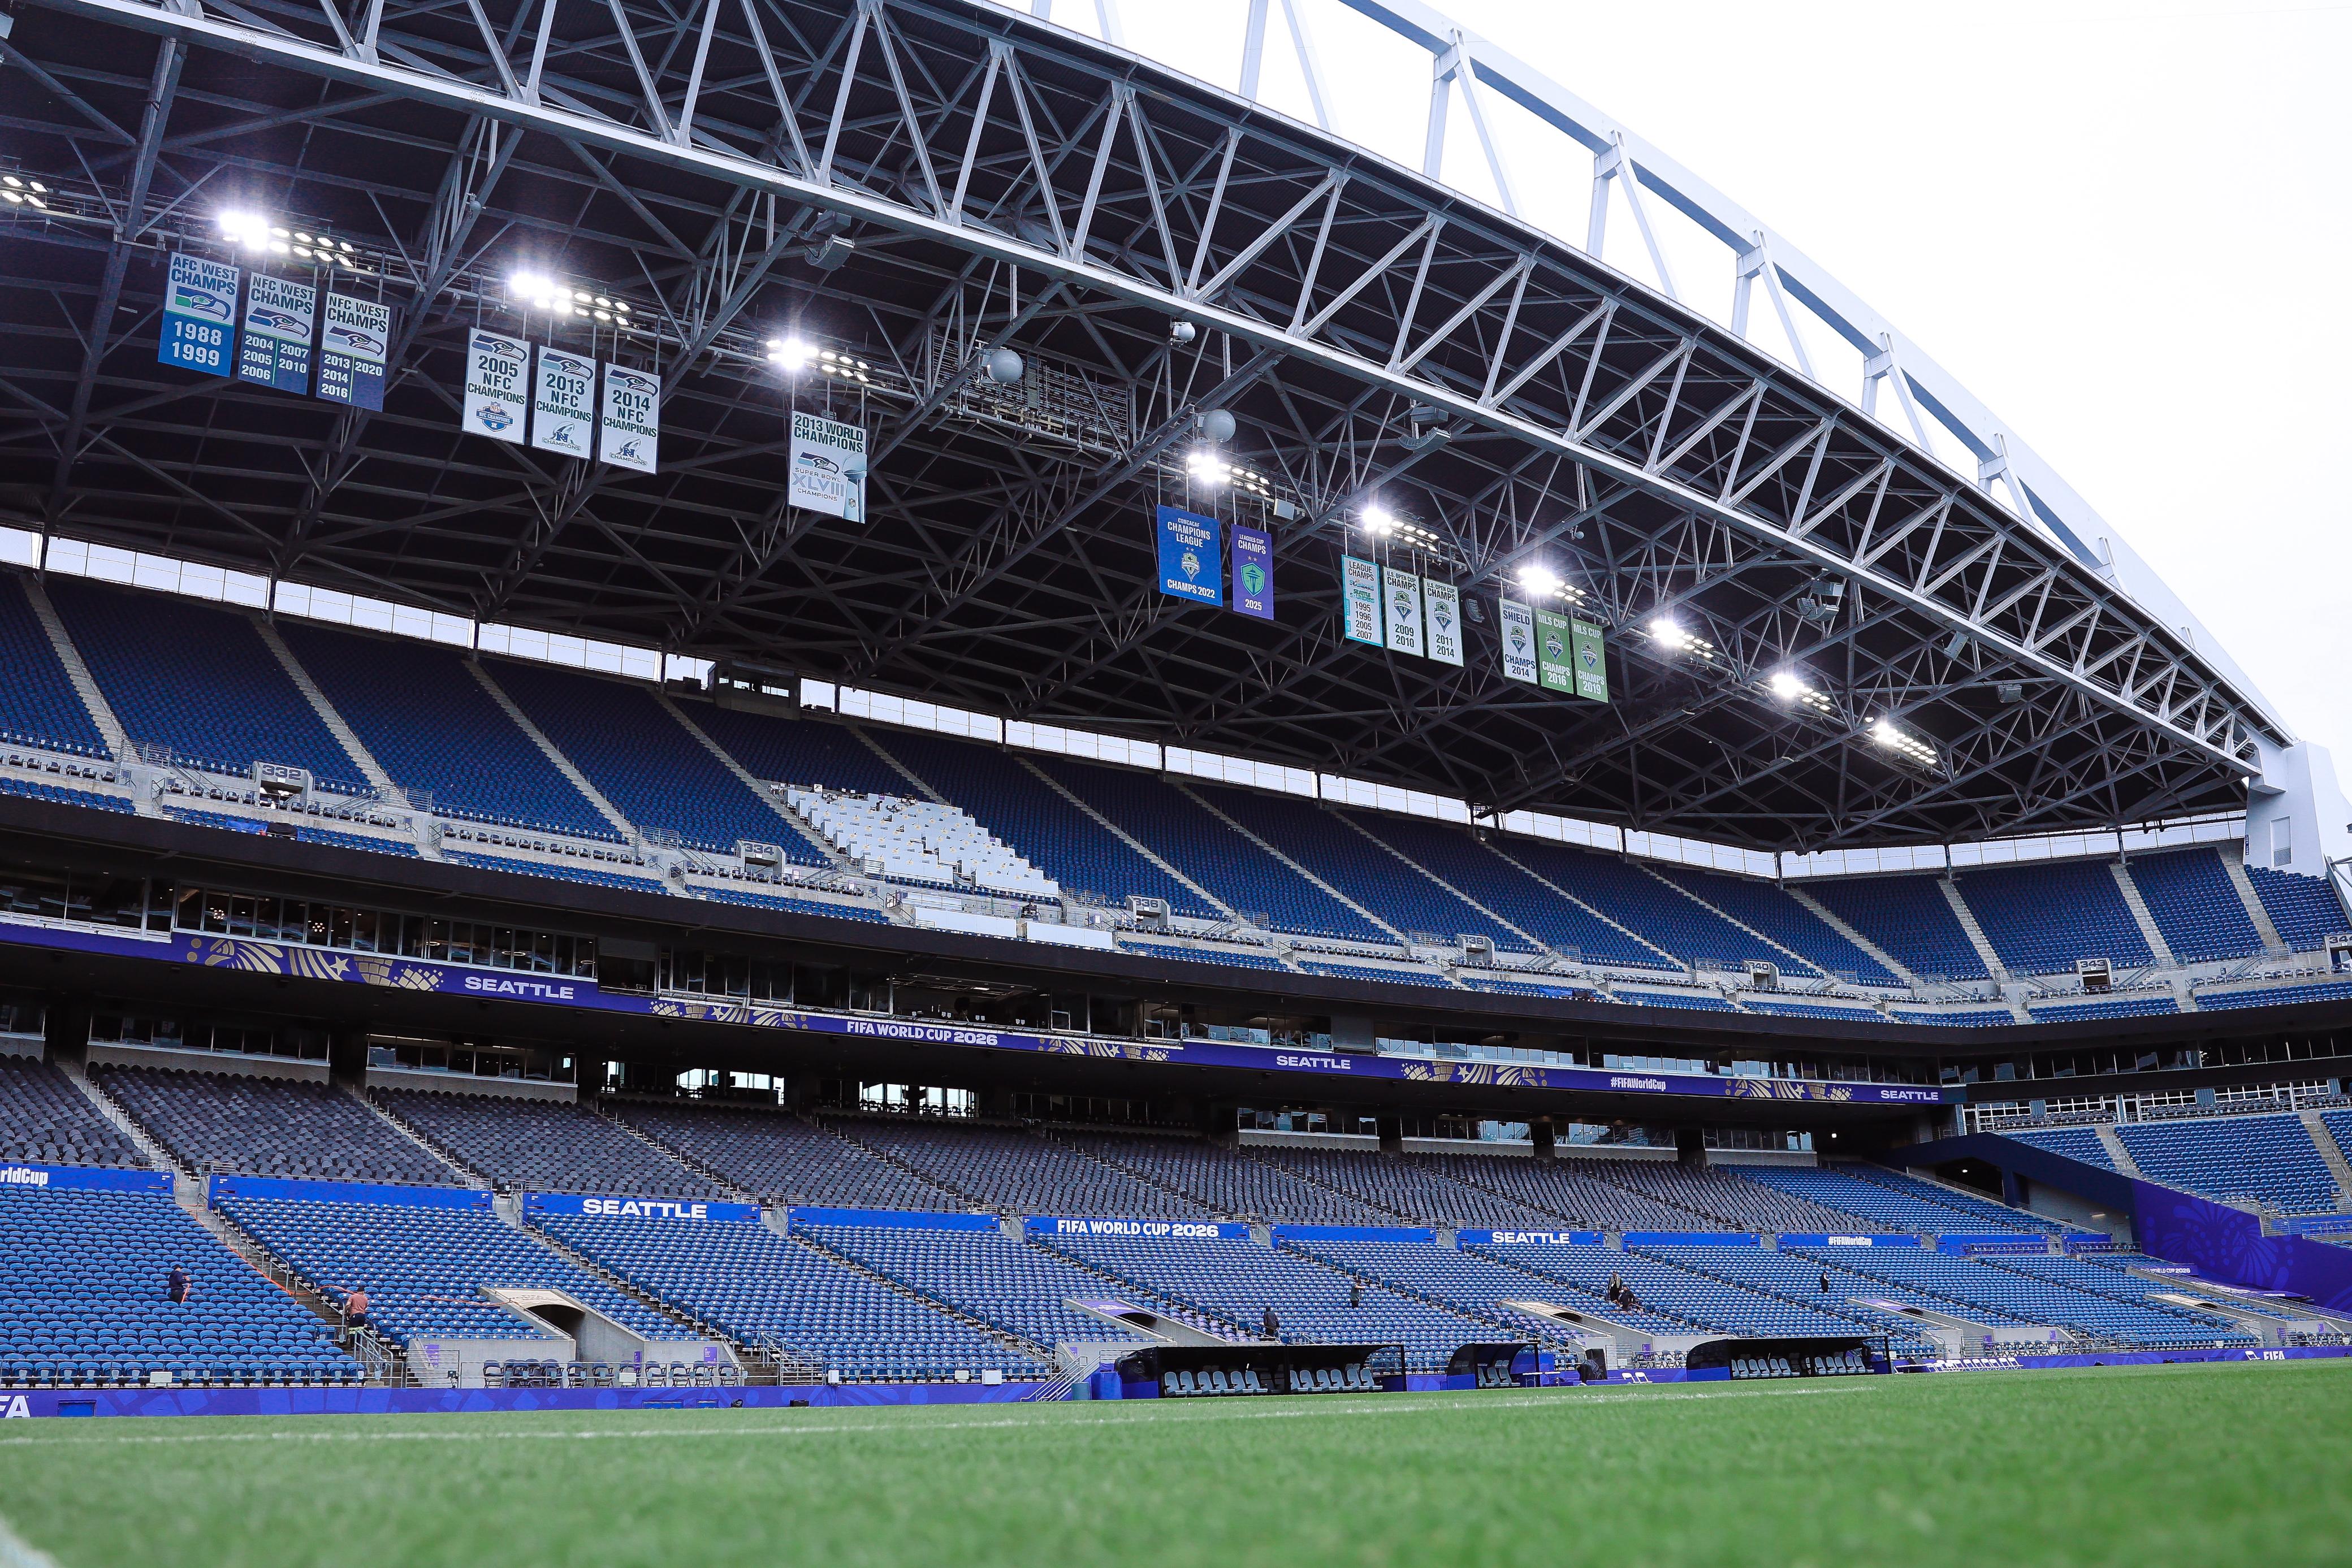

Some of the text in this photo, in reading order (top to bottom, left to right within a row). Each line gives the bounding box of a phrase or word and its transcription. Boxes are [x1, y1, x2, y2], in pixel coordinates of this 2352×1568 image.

[172, 257, 237, 281] AFC WEST
[171, 268, 236, 296] CHAMPS
[253, 277, 315, 300] NFC WEST
[251, 288, 313, 314] CHAMPS
[328, 296, 389, 319] NFC WEST
[327, 307, 387, 333] CHAMPS
[174, 321, 222, 346] 1988
[245, 335, 274, 350] 2004
[172, 342, 220, 366] 1999
[243, 350, 272, 366] 2005
[280, 344, 309, 358] 2007
[278, 358, 306, 373] 2010
[324, 354, 351, 368] 2013
[478, 355, 518, 378] 2005
[241, 365, 271, 380] 2006
[322, 369, 349, 383] 2014
[355, 362, 382, 376] 2020
[483, 372, 512, 389] NFC
[546, 372, 585, 396] 2013
[321, 383, 348, 398] 2016
[468, 383, 525, 405] CHAMPIONS
[551, 390, 579, 408] NFC
[612, 389, 650, 412] 2014
[536, 401, 591, 422] CHAMPIONS
[617, 406, 645, 423] NFC
[603, 417, 657, 438] CHAMPIONS
[794, 414, 863, 441] 2013 WORLD
[543, 439, 580, 451] CHAMPIONS
[794, 426, 863, 453] CHAMPIONS
[610, 454, 646, 466] CHAMPIONS
[795, 467, 841, 483] SUPER BOWL
[792, 473, 844, 497] XLVIII
[797, 488, 837, 501] CHAMPIONS
[1178, 518, 1200, 527] CONCACAF
[1168, 521, 1210, 540] CHAMPIONS
[1176, 533, 1203, 548] LEAGUE
[1239, 534, 1256, 543] LEAGUES
[1238, 540, 1266, 555] CHAMPS
[1348, 568, 1374, 582] CHAMPS
[1349, 561, 1372, 574] LEAGUE
[1167, 579, 1216, 599] CHAMPS 2022
[1387, 577, 1417, 592] CHAMPS
[1427, 587, 1456, 603] CHAMPS
[1245, 599, 1262, 610] 2025
[1355, 601, 1371, 612] 1995
[1355, 610, 1371, 621] 1996
[1503, 610, 1530, 626] SHIELD
[1538, 614, 1567, 630] MLS CUP
[1356, 620, 1372, 631] 2005
[1395, 623, 1414, 636] 2009
[1573, 623, 1601, 639] MLS CUP
[1356, 629, 1372, 640] 2007
[1395, 635, 1415, 648] 2010
[1436, 634, 1453, 646] 2011
[1437, 645, 1455, 658] 2014
[1504, 654, 1536, 669] CHAMPS
[1542, 661, 1571, 677] CHAMPS
[1512, 665, 1529, 677] 2014
[1577, 670, 1605, 686] CHAMPS
[1547, 672, 1567, 687] 2016
[1583, 681, 1601, 695] 2019
[262, 764, 301, 781] 332
[743, 842, 774, 855] 334
[1134, 898, 1158, 908] 336
[465, 976, 574, 999] SEATTLE
[847, 1021, 998, 1046] FIFA WORLD CUP 2026
[1276, 1055, 1351, 1069] SEATTLE
[1610, 1077, 1666, 1091] #FIFAWorldCup
[1880, 1090, 1939, 1101] SEATTLE
[0, 1167, 49, 1187] rldCup
[583, 1198, 707, 1219] SEATTLE
[1057, 1220, 1219, 1237] FIFA WORLD CUP 2026
[1492, 1231, 1570, 1244] SEATTLE
[1828, 1236, 1872, 1247] #FIFAWorldCup
[2263, 1350, 2285, 1361] FIFA
